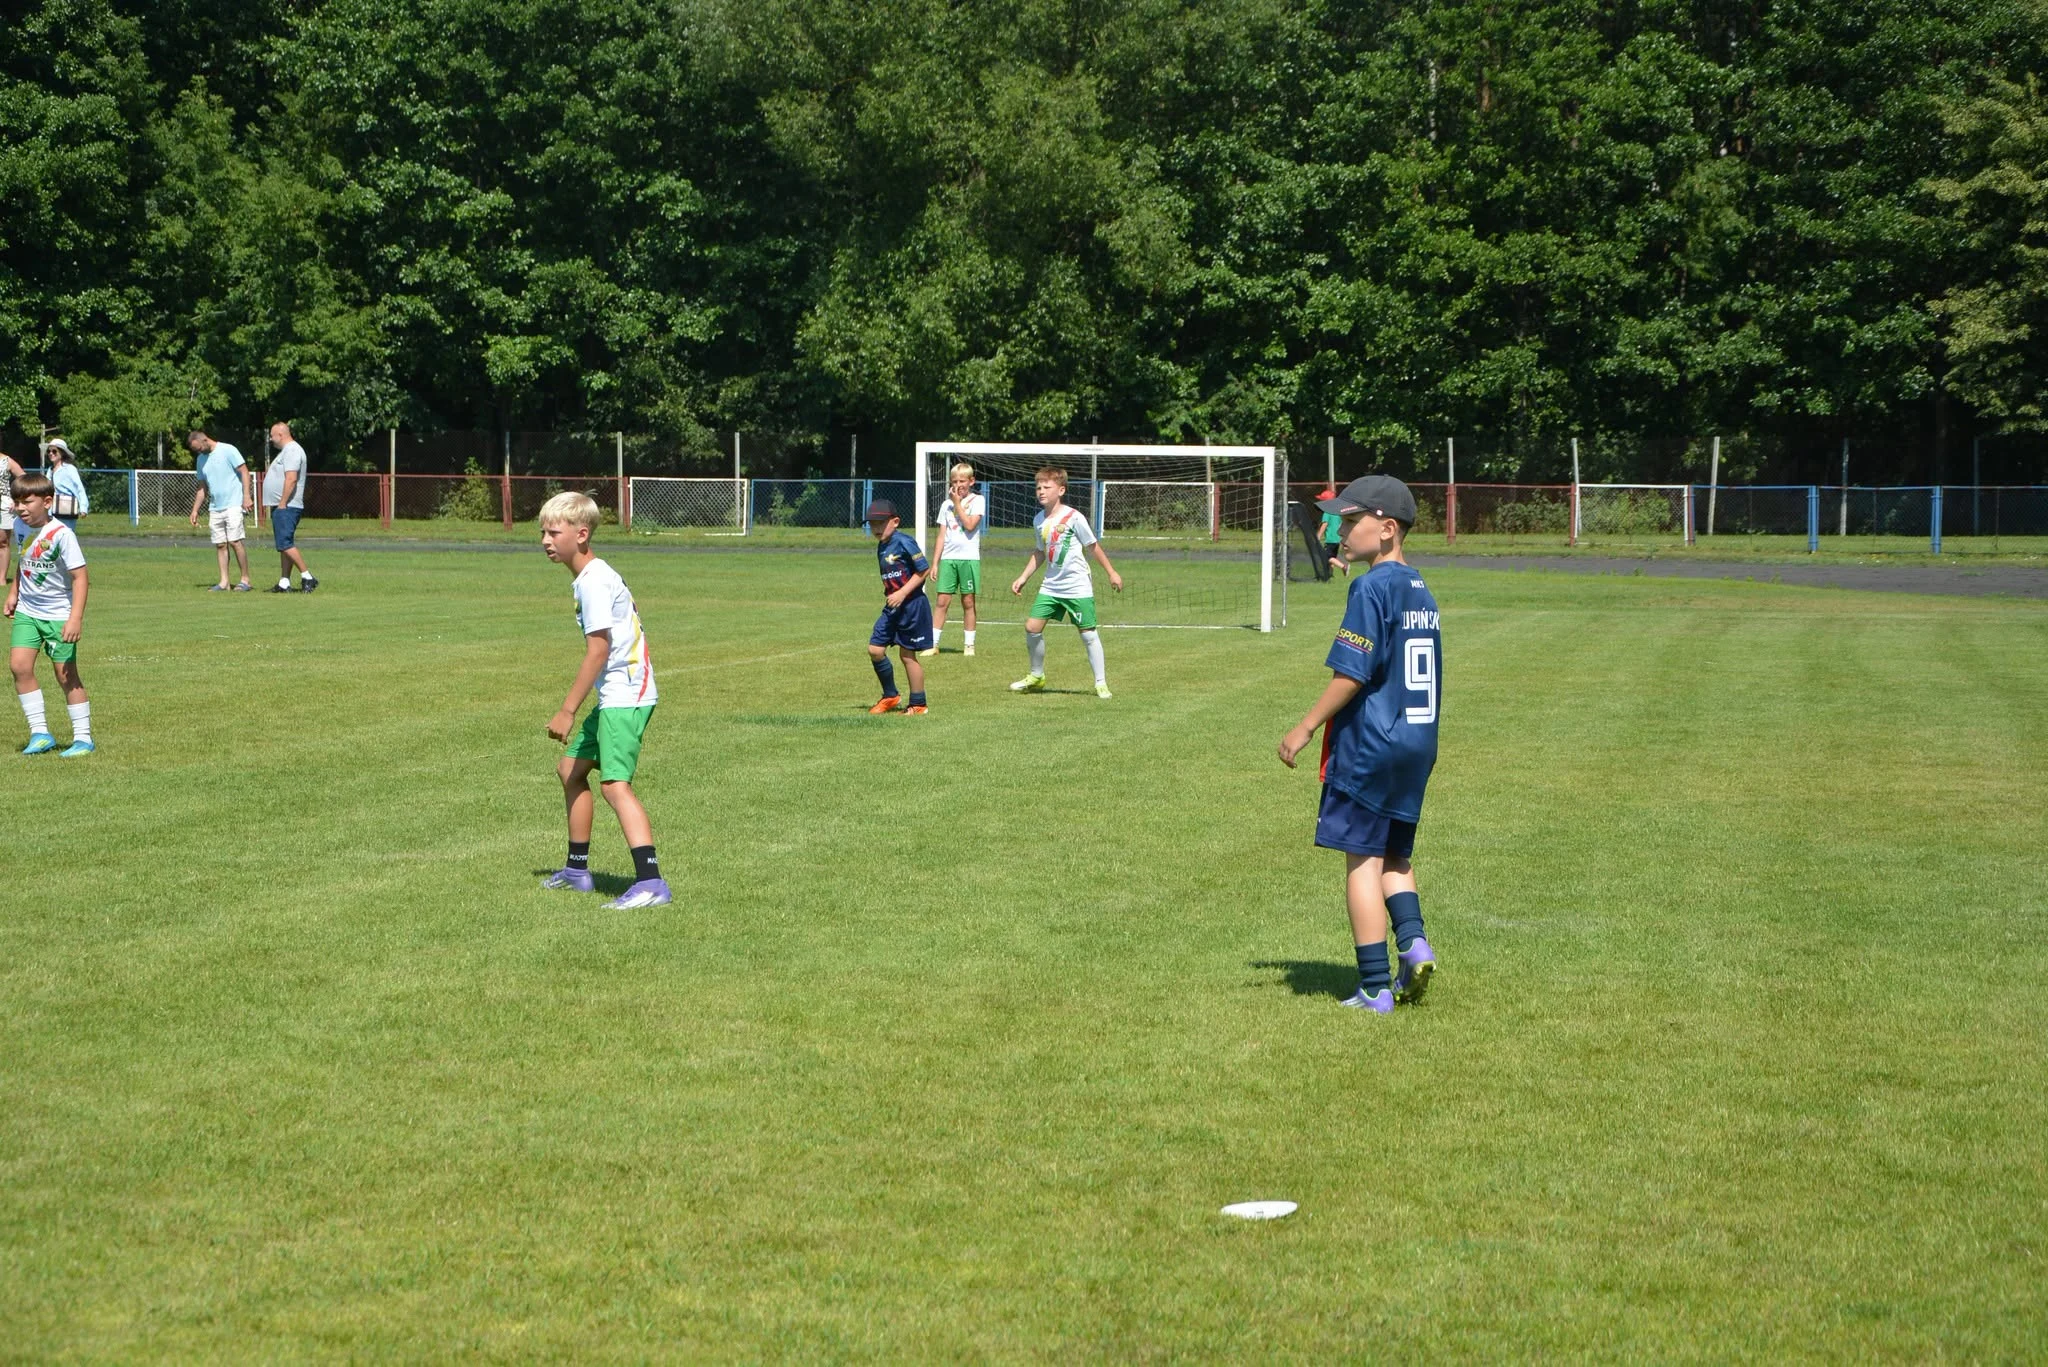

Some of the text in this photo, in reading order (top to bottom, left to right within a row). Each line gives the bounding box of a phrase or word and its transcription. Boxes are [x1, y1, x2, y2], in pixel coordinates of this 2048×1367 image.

[967, 580, 974, 590] 5
[1337, 628, 1374, 651] SPORTS
[1404, 638, 1437, 724] 9
